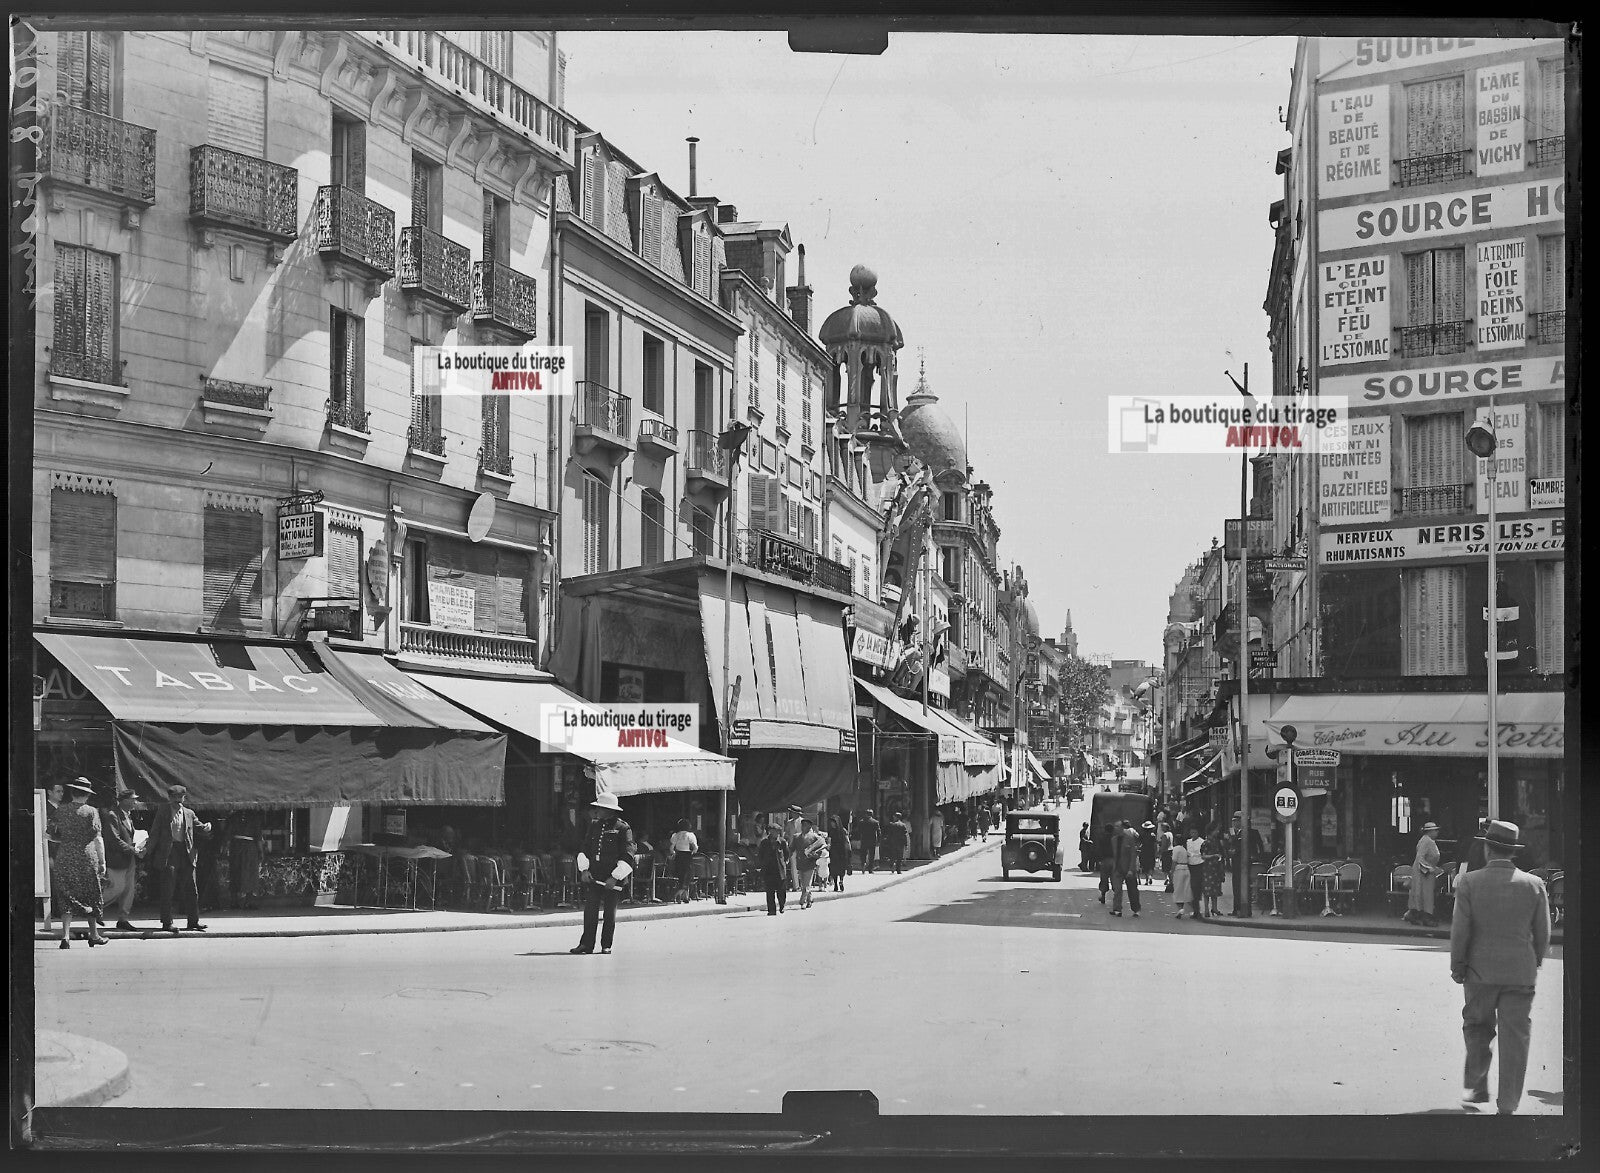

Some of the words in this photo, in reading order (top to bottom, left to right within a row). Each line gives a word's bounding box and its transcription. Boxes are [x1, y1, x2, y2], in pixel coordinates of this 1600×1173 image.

[1331, 94, 1373, 113] L'EAU
[1491, 92, 1509, 104] DU
[1343, 112, 1364, 124] DE
[1478, 105, 1521, 126] BASSIN
[1328, 122, 1379, 145] BEAUTÉ
[1489, 129, 1507, 141] DE
[1340, 146, 1350, 158] ET
[1357, 144, 1370, 156] DE
[1478, 143, 1523, 165] VICHY
[1326, 155, 1382, 182] RÉGIME
[1355, 193, 1492, 240] SOURCE
[1325, 260, 1385, 282] L'EAU
[1489, 260, 1511, 270] DU
[1338, 279, 1367, 290] QUI
[1485, 269, 1518, 290] FOIE
[1487, 288, 1514, 298] DES
[1343, 306, 1364, 315] LE
[1480, 295, 1524, 317] REINS
[1338, 314, 1370, 333] FEU
[1491, 316, 1509, 324] DE
[1343, 333, 1364, 341] DE
[1478, 323, 1525, 344] L'ESTOMAC
[1323, 338, 1389, 361] L'ESTOMAC
[1363, 364, 1523, 401] SOURCE
[1324, 425, 1348, 437] CES
[1351, 423, 1385, 436] EAUX
[1365, 439, 1380, 449] NI
[1343, 471, 1359, 480] NI
[280, 516, 314, 530] LOTERIE
[280, 528, 314, 542] NATIONALE
[1336, 530, 1394, 545] NERVEUX
[1525, 542, 1539, 550] DE
[1325, 546, 1406, 562] RHUMATISANTS
[430, 583, 469, 599] CHAMBRES
[94, 664, 319, 694] TABAC
[1384, 725, 1457, 748] Au
